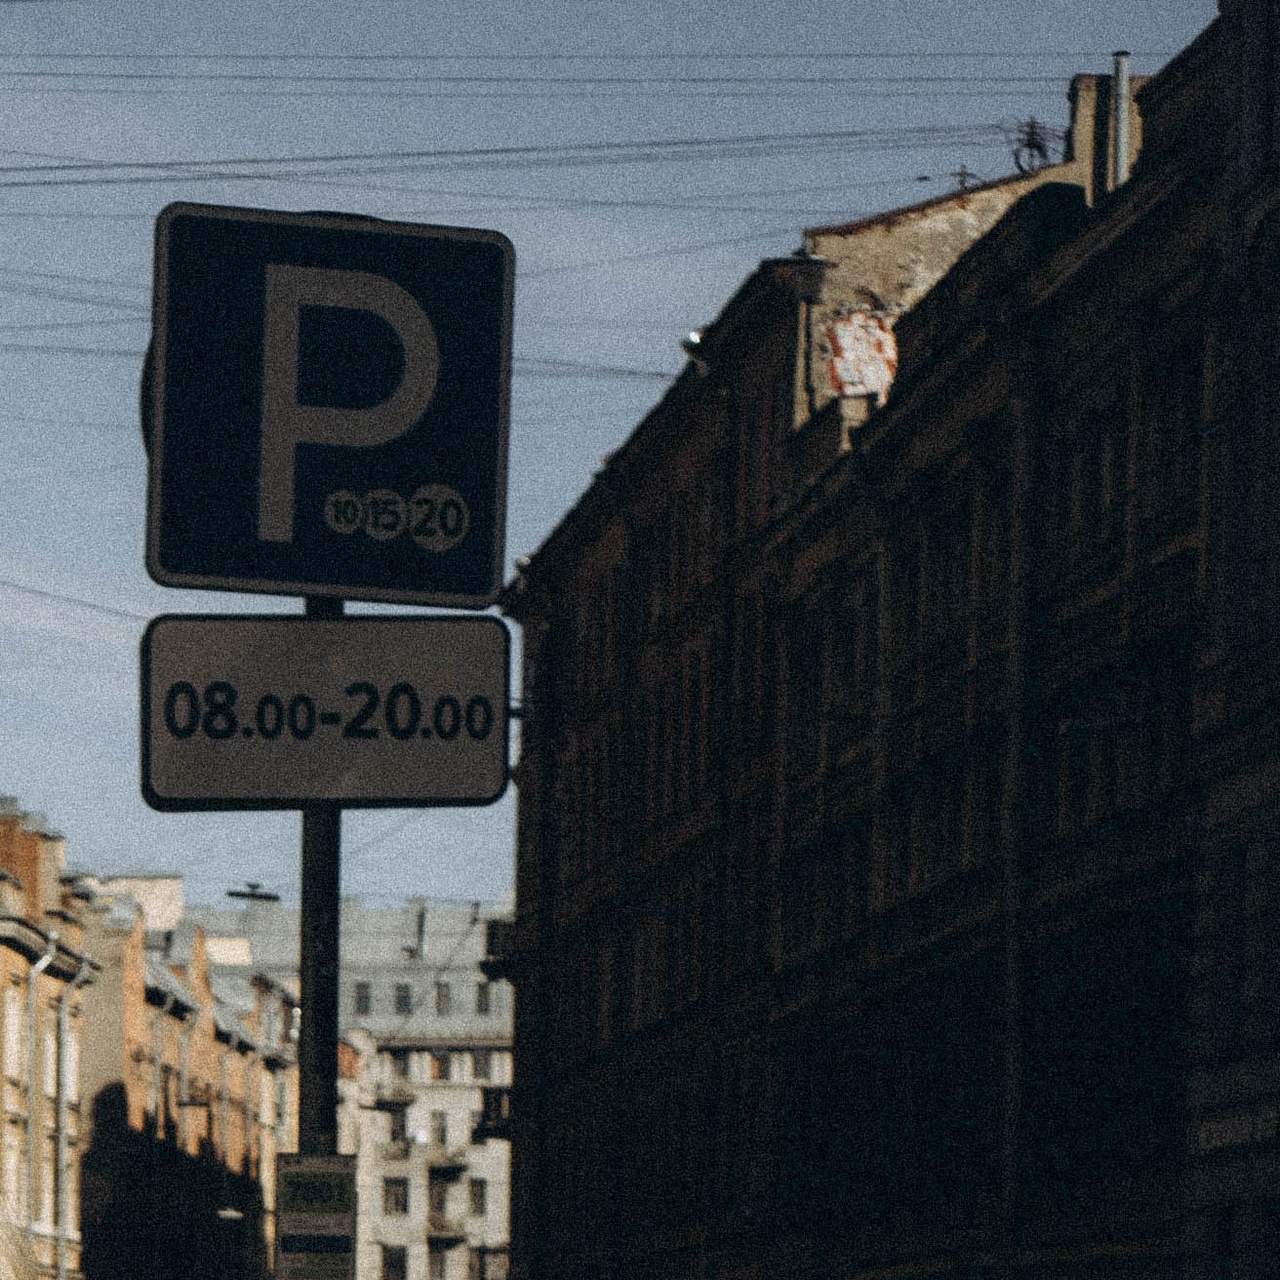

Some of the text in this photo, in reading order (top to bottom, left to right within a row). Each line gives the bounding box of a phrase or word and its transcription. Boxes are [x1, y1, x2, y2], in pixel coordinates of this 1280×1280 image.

[260, 264, 440, 543] P
[332, 497, 465, 539] 10 15 20
[165, 680, 493, 740] 08.00-20.00
